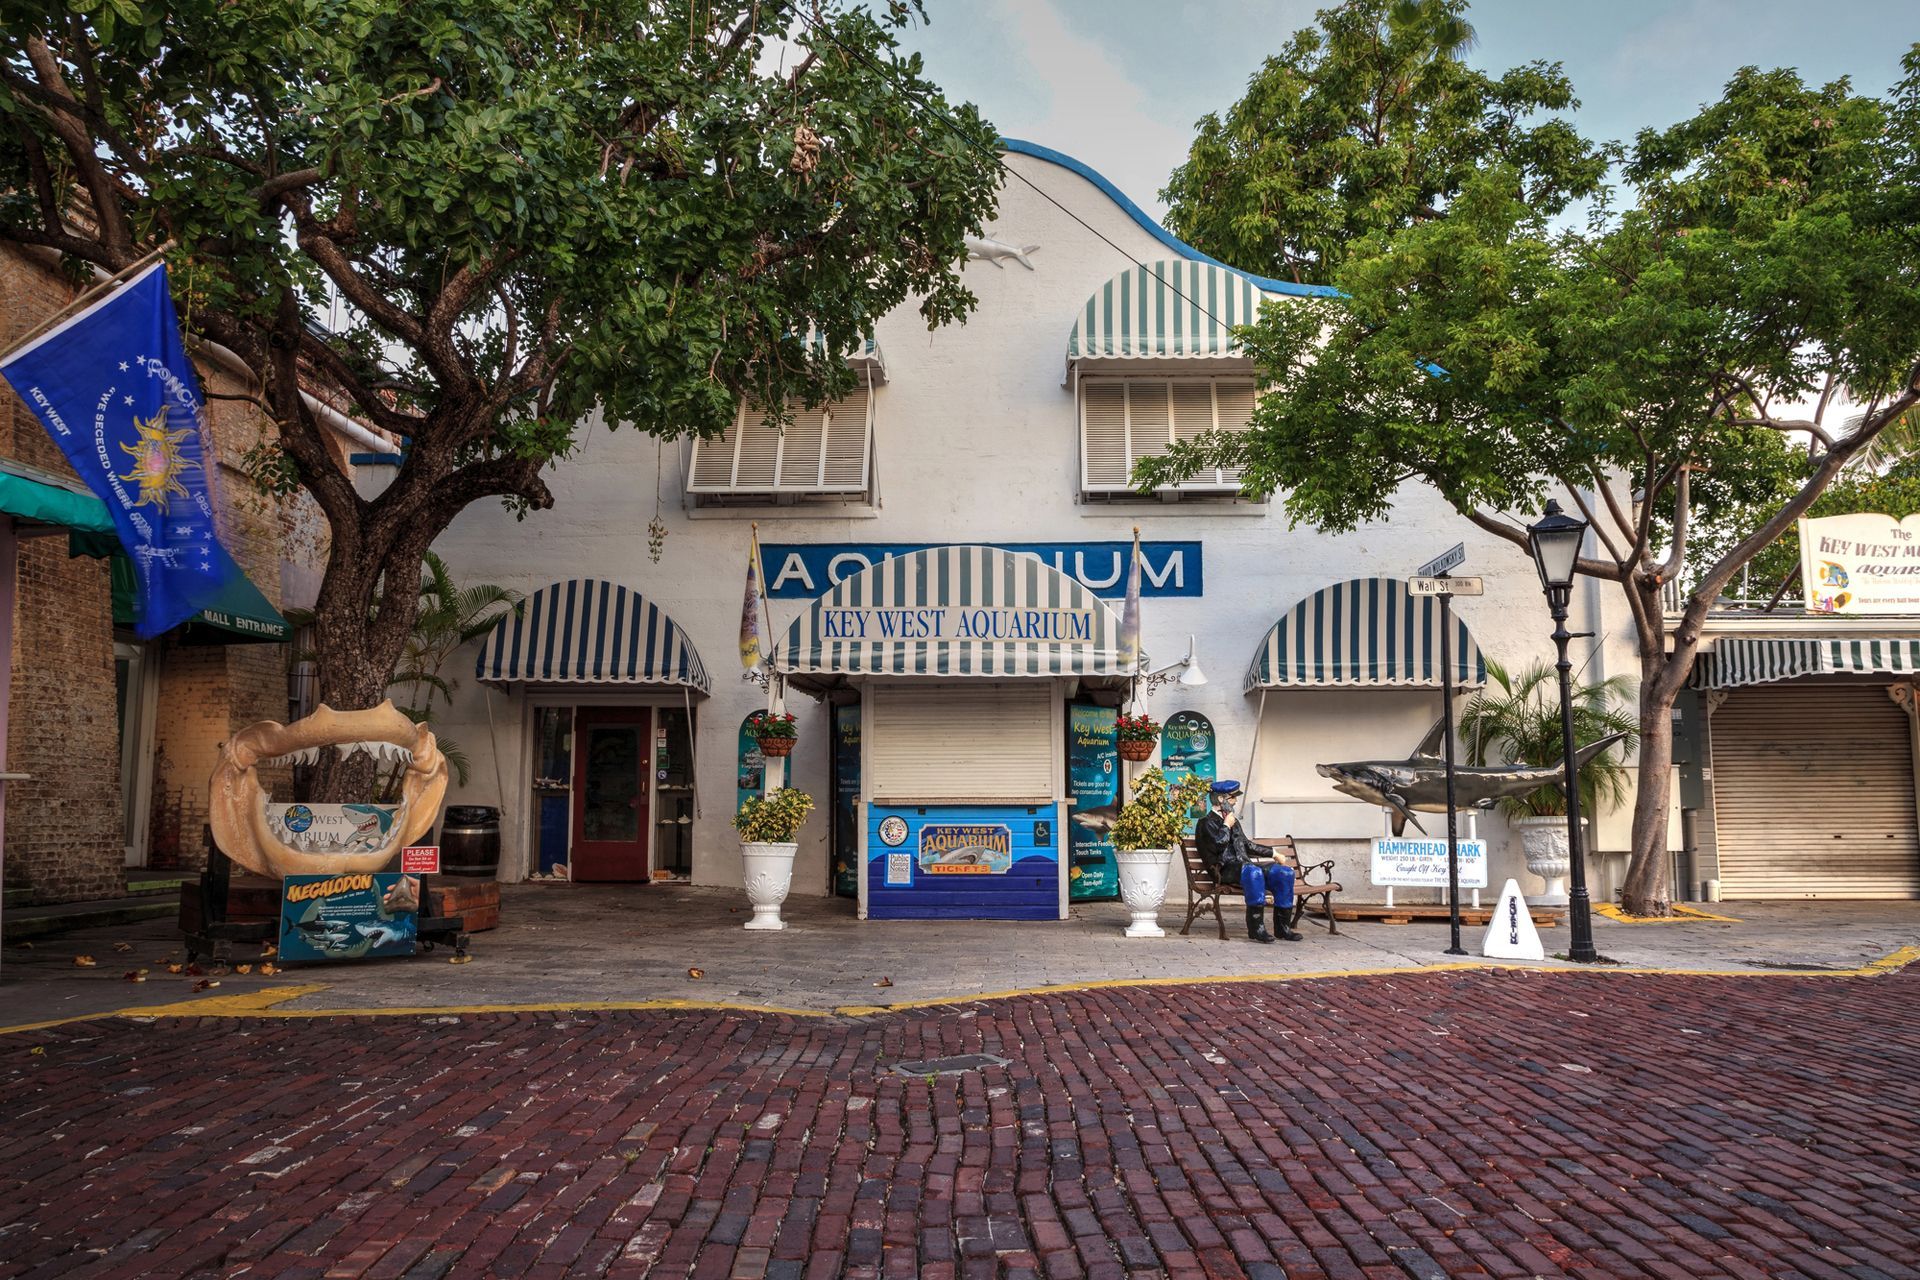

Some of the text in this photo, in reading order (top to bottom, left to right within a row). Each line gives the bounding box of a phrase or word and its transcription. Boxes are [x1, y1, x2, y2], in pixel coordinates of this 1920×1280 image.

[29, 387, 71, 437] KEY WEST
[95, 414, 111, 469] SECEDED
[107, 471, 135, 510] WHERE
[193, 491, 212, 518] 1982
[1891, 529, 1912, 541] The
[1820, 537, 1851, 555] KEY
[1855, 543, 1900, 557] WEST
[1418, 580, 1435, 592] Wall
[1440, 580, 1449, 592] St
[204, 609, 284, 636] MALL ENTRANCE
[824, 609, 1091, 640] KEY WEST AQUARIUM
[1074, 722, 1113, 736] Key West
[1167, 730, 1211, 740] AQUARIUM
[1078, 736, 1109, 747] Aquarium
[1095, 781, 1104, 789] good
[924, 835, 1006, 855] AQUARIUM
[1378, 841, 1446, 856] HAMMERHEAD
[1395, 863, 1417, 874] Caught
[1418, 864, 1430, 874] Off
[1431, 863, 1447, 875] Key
[287, 874, 373, 902] MEGALODON
